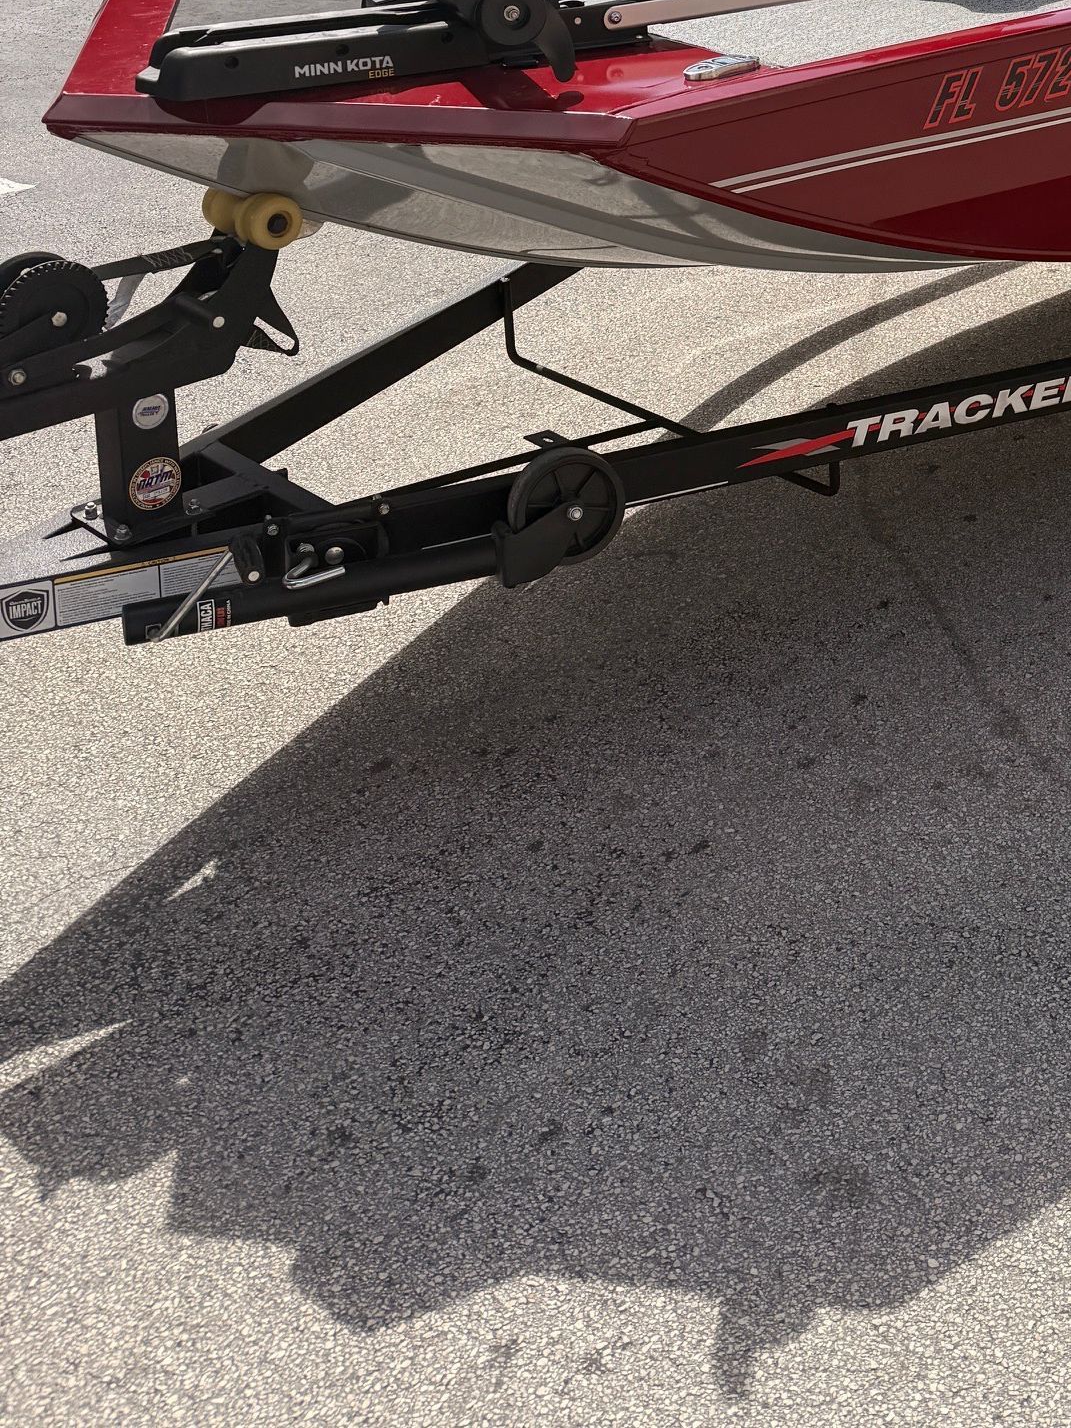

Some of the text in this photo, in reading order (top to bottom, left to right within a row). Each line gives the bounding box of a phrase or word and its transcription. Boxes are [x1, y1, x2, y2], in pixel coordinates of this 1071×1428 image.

[294, 55, 394, 78] MINN KOTA
[368, 68, 395, 79] EDGE
[923, 66, 984, 130] FL
[9, 600, 42, 620] IMPACT
